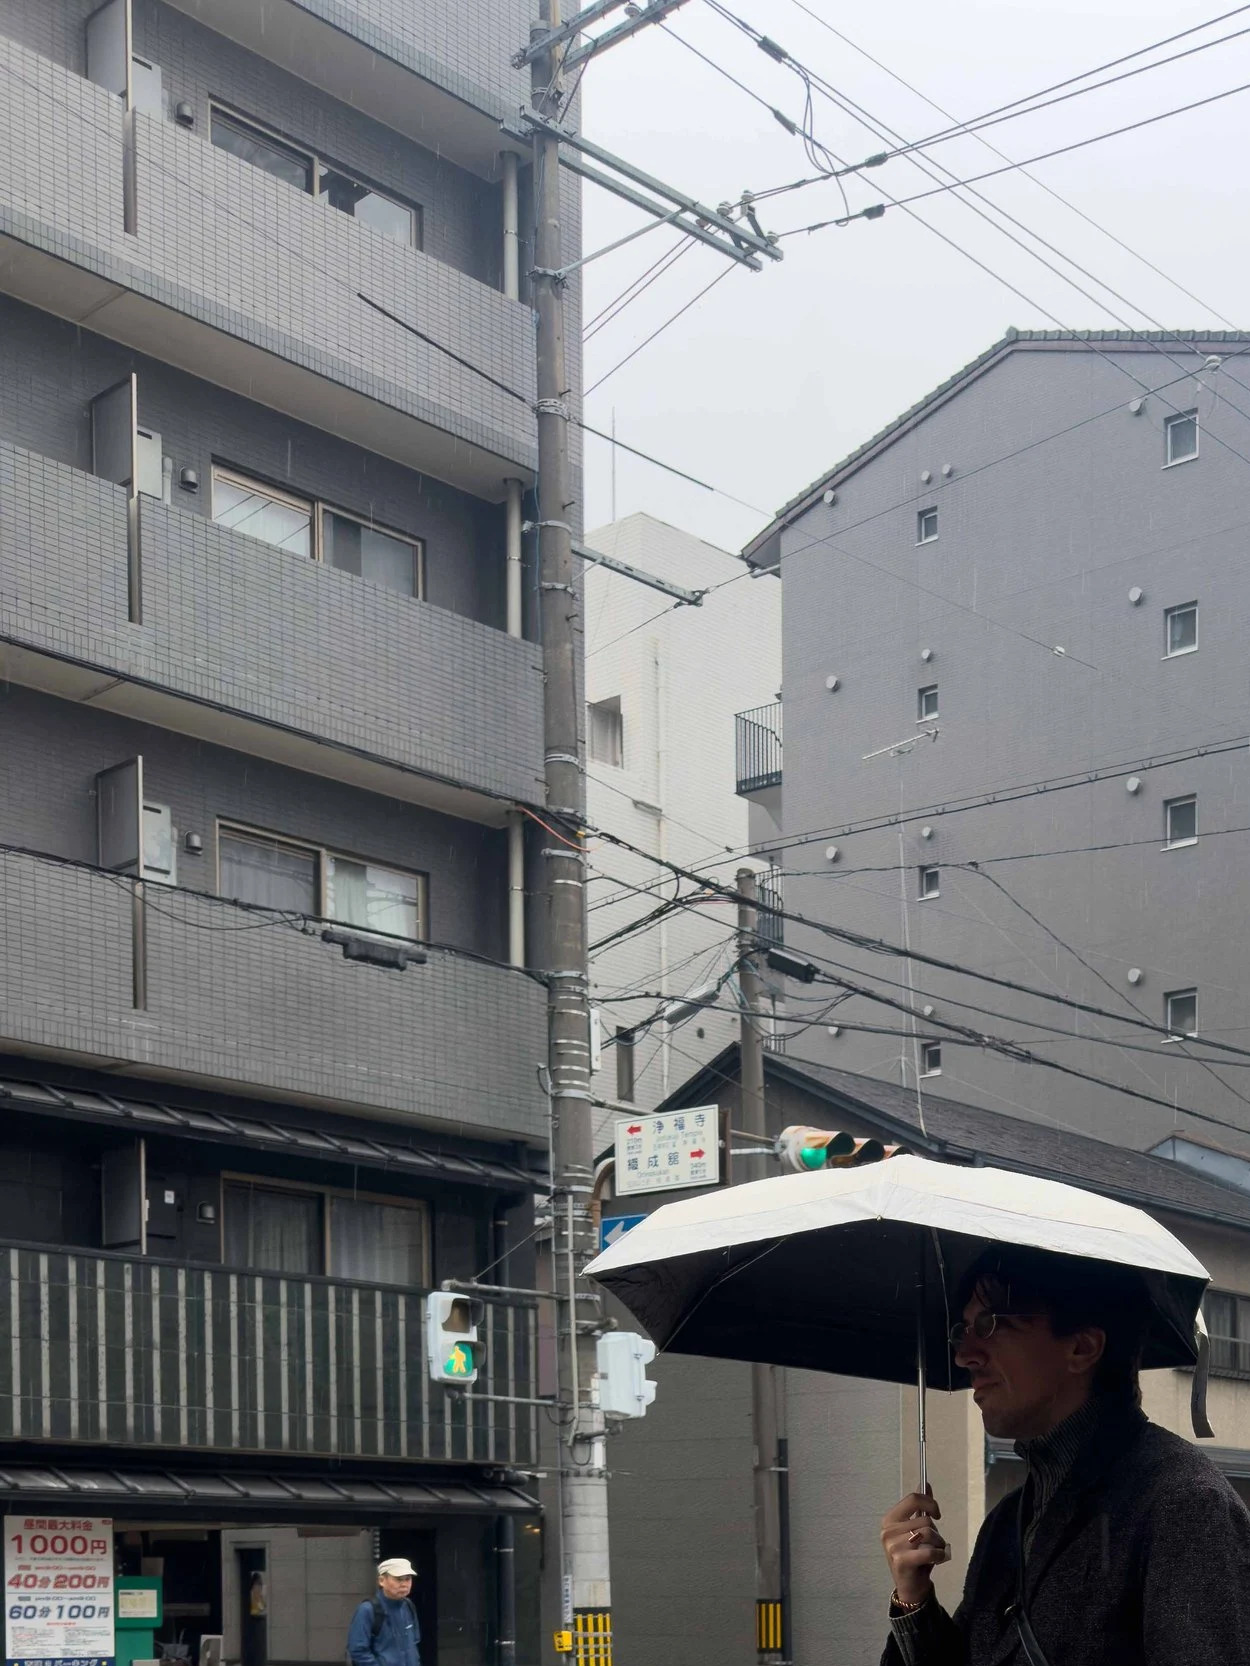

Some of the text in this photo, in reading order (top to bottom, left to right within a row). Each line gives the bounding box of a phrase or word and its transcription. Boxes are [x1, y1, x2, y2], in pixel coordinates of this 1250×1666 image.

[652, 1114, 706, 1134] 浄福寺
[24, 1518, 93, 1531] 昼間最大料金
[11, 1534, 107, 1555] 1000円
